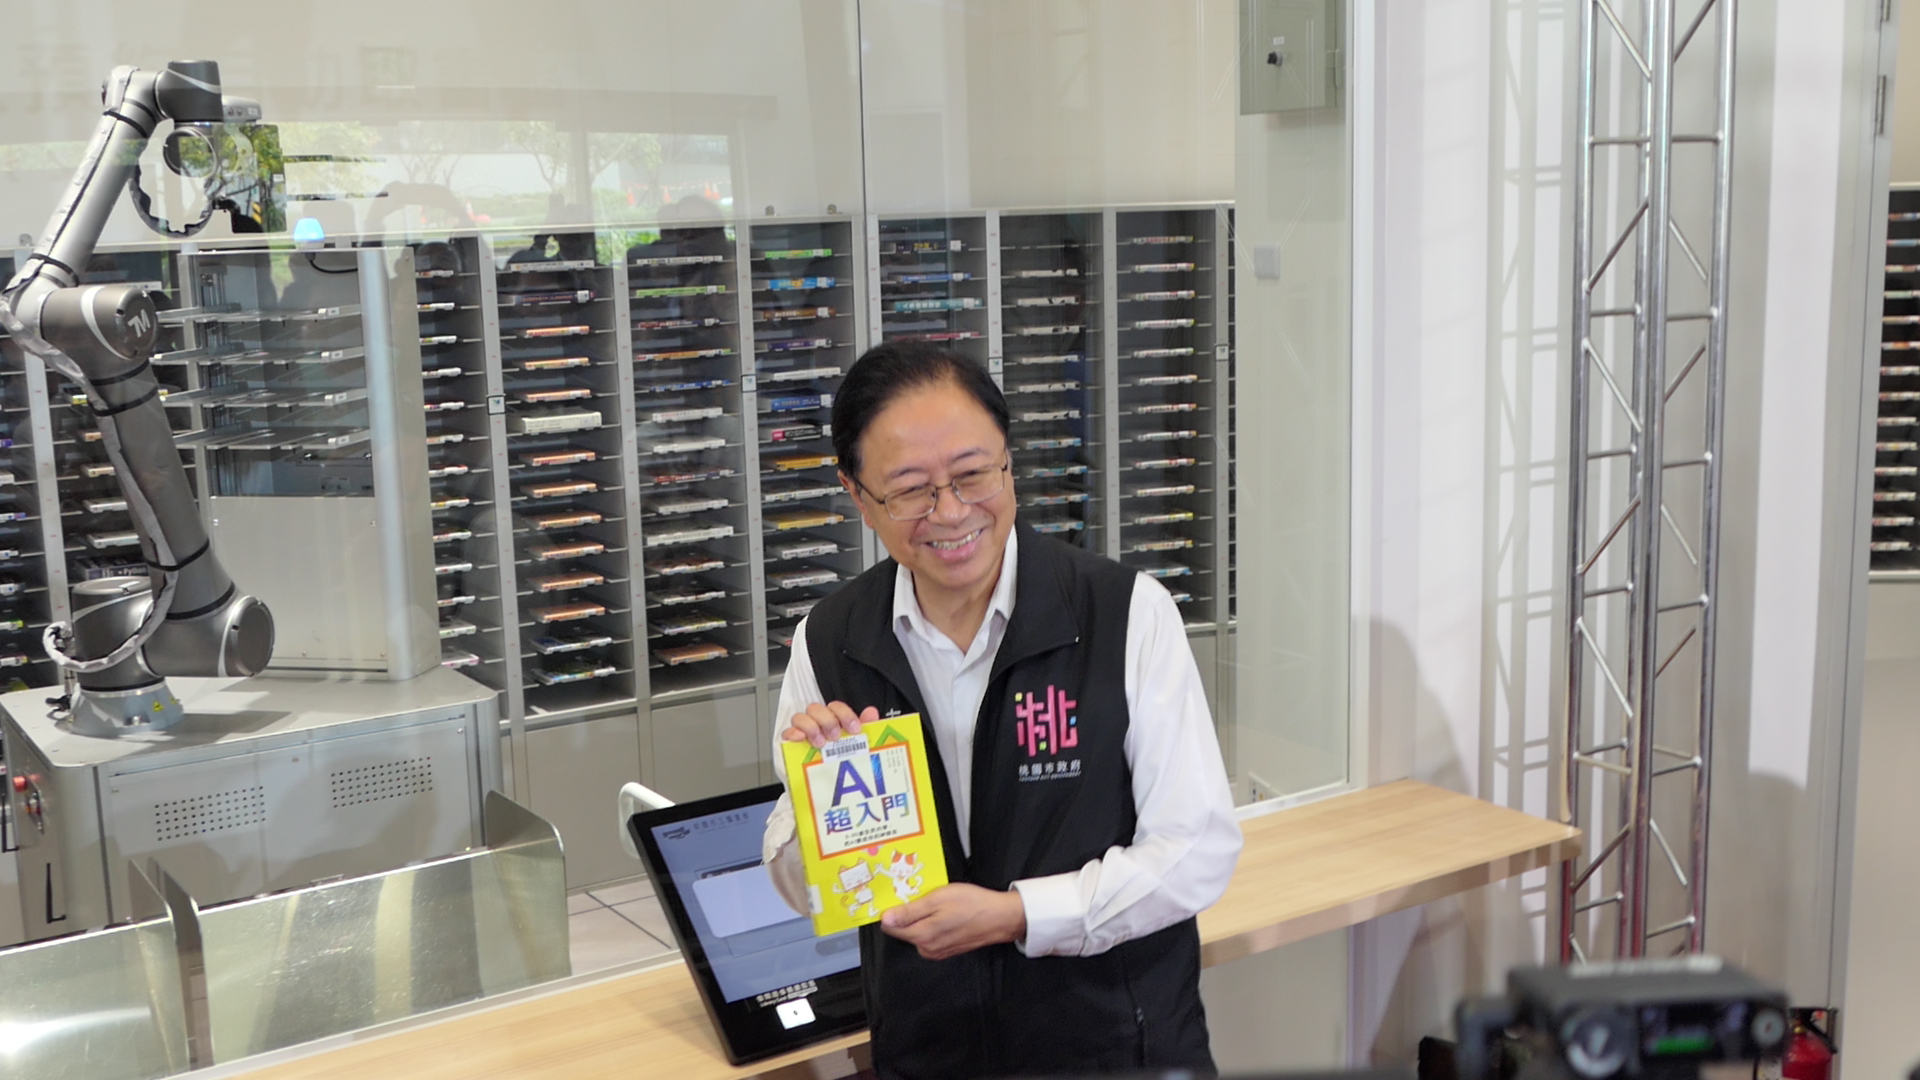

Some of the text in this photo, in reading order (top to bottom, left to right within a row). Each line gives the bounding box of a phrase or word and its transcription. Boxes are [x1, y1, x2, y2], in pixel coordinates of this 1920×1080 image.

[831, 753, 886, 807] AI
[1019, 759, 1081, 775] 桃園市政府
[824, 793, 910, 835] 超入門
